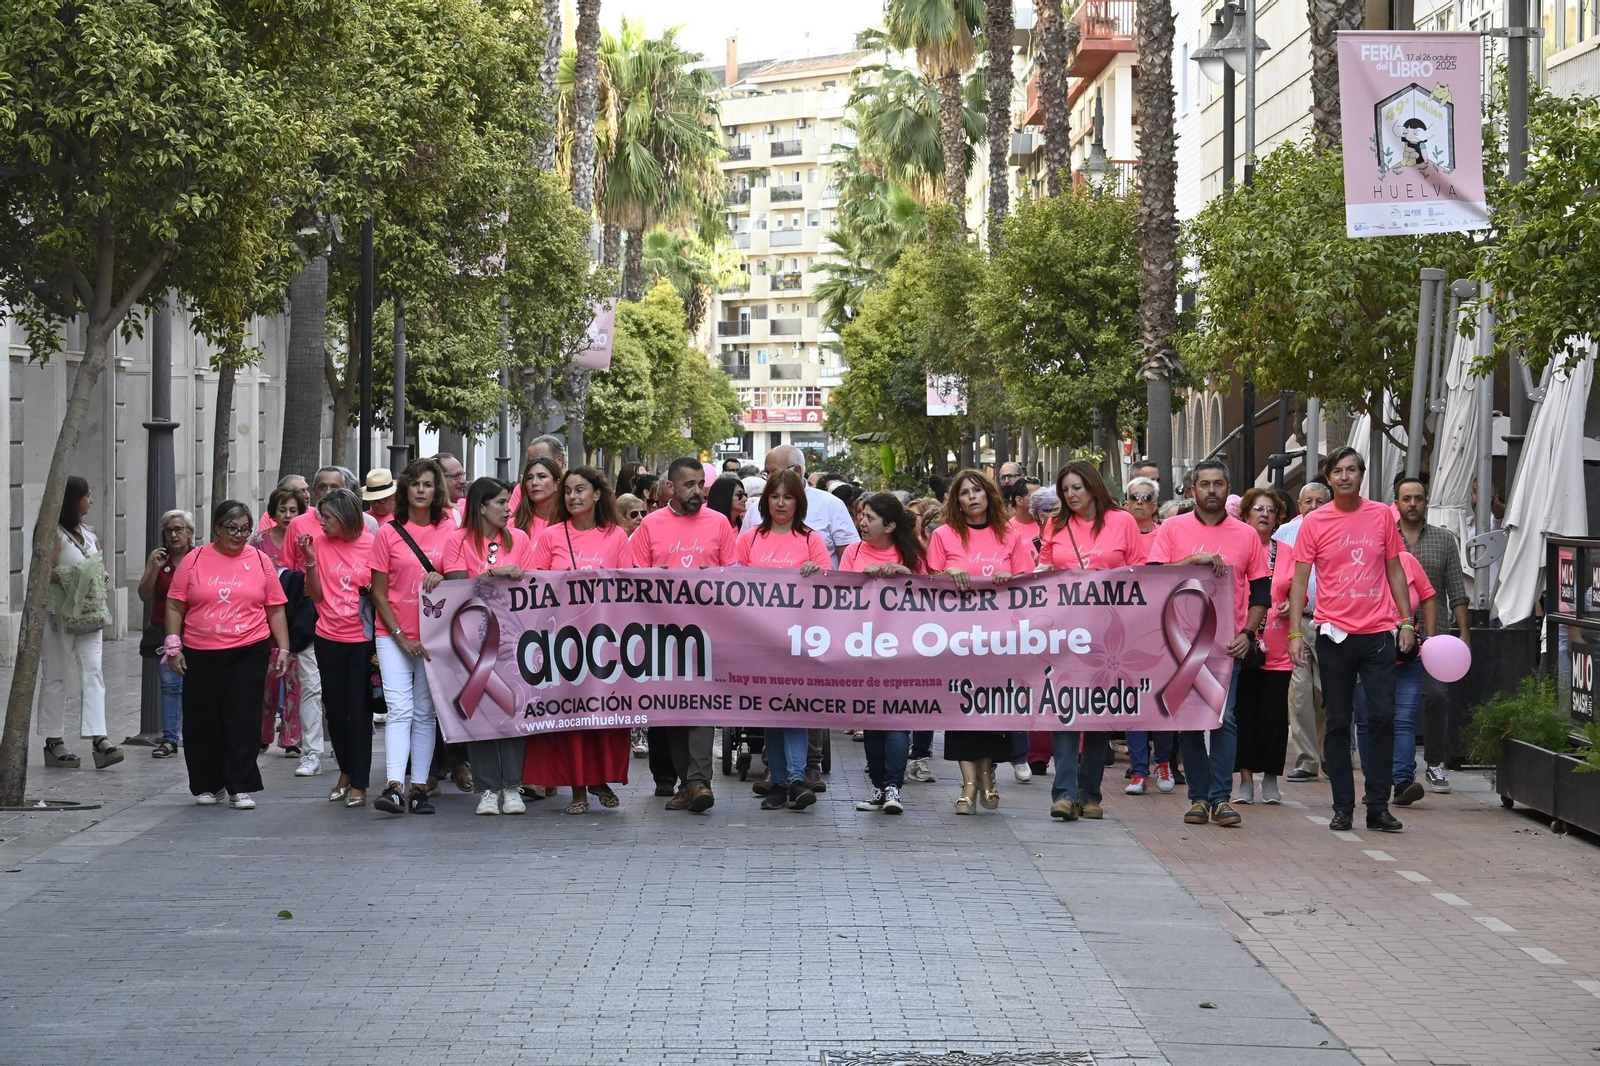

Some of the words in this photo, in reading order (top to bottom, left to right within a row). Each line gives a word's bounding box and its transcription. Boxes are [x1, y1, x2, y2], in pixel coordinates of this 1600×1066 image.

[1361, 44, 1405, 61] FERIA
[1432, 53, 1457, 61] octubre
[1376, 62, 1388, 70] del
[1389, 61, 1434, 78] LIBRO
[1435, 61, 1457, 70] 2025
[1373, 183, 1458, 199] HUELVA
[669, 539, 705, 554] Unidos
[1338, 531, 1374, 548] Unidos
[760, 551, 796, 566] Unidos
[508, 577, 561, 612] DÍA
[566, 578, 804, 608] INTERNACIONAL
[812, 584, 871, 610] DEL
[879, 580, 999, 613] CÁNCER
[1008, 585, 1049, 610] DE
[1057, 580, 1147, 606] MAMA
[787, 623, 831, 658] 19
[844, 621, 899, 658] de
[912, 619, 1092, 658] Octubre
[517, 622, 710, 688] aocam
[752, 676, 768, 685] un
[769, 676, 805, 687] nuevo
[806, 677, 864, 688] amanecer
[866, 676, 881, 688] de
[883, 678, 943, 690] esperanza
[524, 691, 633, 719] ASOCIACIÓN
[638, 694, 732, 710] ONUBENSE
[739, 695, 762, 711] DE
[768, 693, 846, 713] CÁNCER
[852, 699, 876, 714] DE
[882, 699, 942, 714] MAMA
[525, 713, 648, 732] www.aocamhuelva.es
